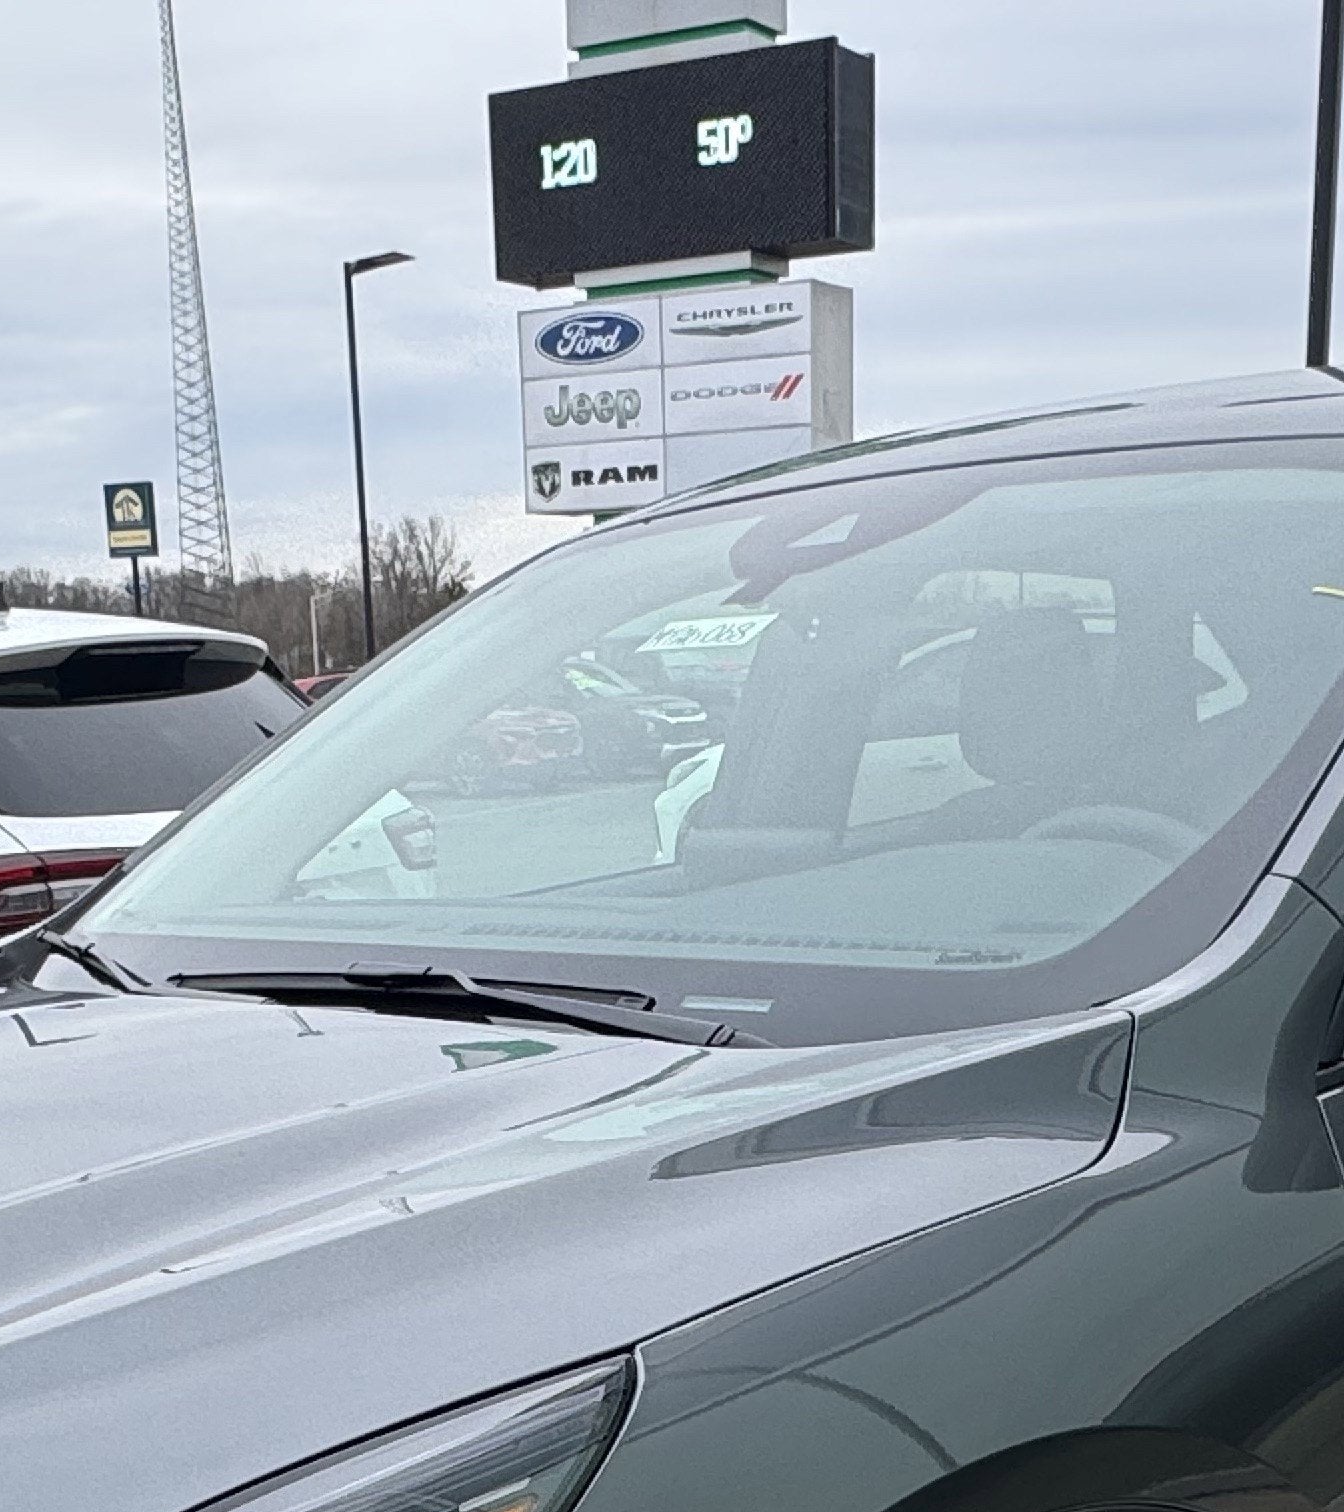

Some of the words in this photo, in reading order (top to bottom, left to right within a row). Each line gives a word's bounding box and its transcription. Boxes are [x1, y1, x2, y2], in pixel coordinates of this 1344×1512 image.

[676, 301, 794, 322] CHRYSLER
[556, 319, 623, 356] Ford
[543, 384, 641, 429] Jeep
[570, 464, 658, 487] RAM
